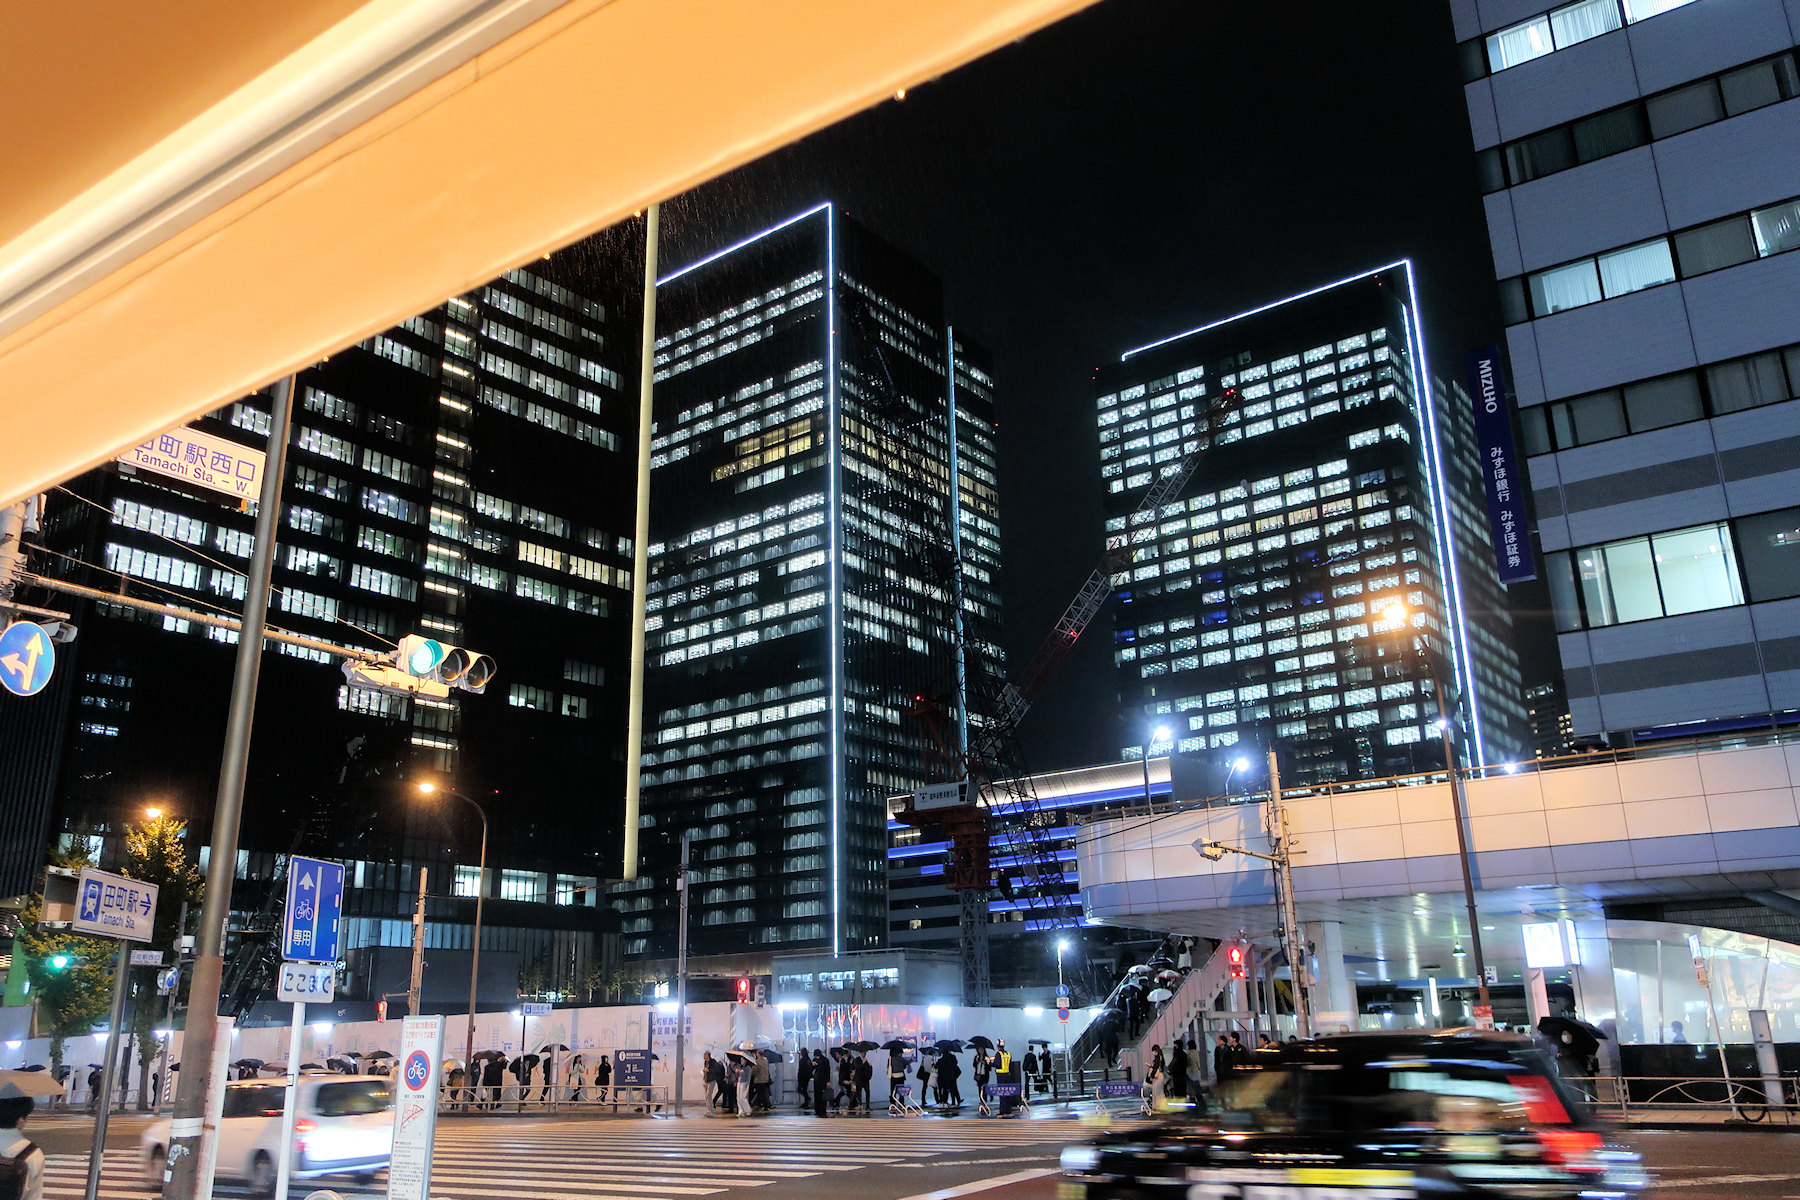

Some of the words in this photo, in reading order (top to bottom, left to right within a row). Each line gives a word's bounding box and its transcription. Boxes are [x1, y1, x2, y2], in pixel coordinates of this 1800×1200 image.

[1478, 358, 1498, 414] MIZUHO
[134, 448, 188, 475] Tamachi
[193, 467, 216, 485] Sta.
[235, 480, 250, 495] W.
[1490, 446, 1510, 503] みずほ銀行
[1500, 510, 1521, 567] みずほ証券
[103, 884, 139, 914] 田町駅
[101, 911, 124, 927] Tamachi
[292, 929, 312, 947] 専用
[284, 973, 331, 994] ここまで
[652, 1016, 692, 1026] 町駅西口前
[652, 1026, 691, 1035] 地区開発業
